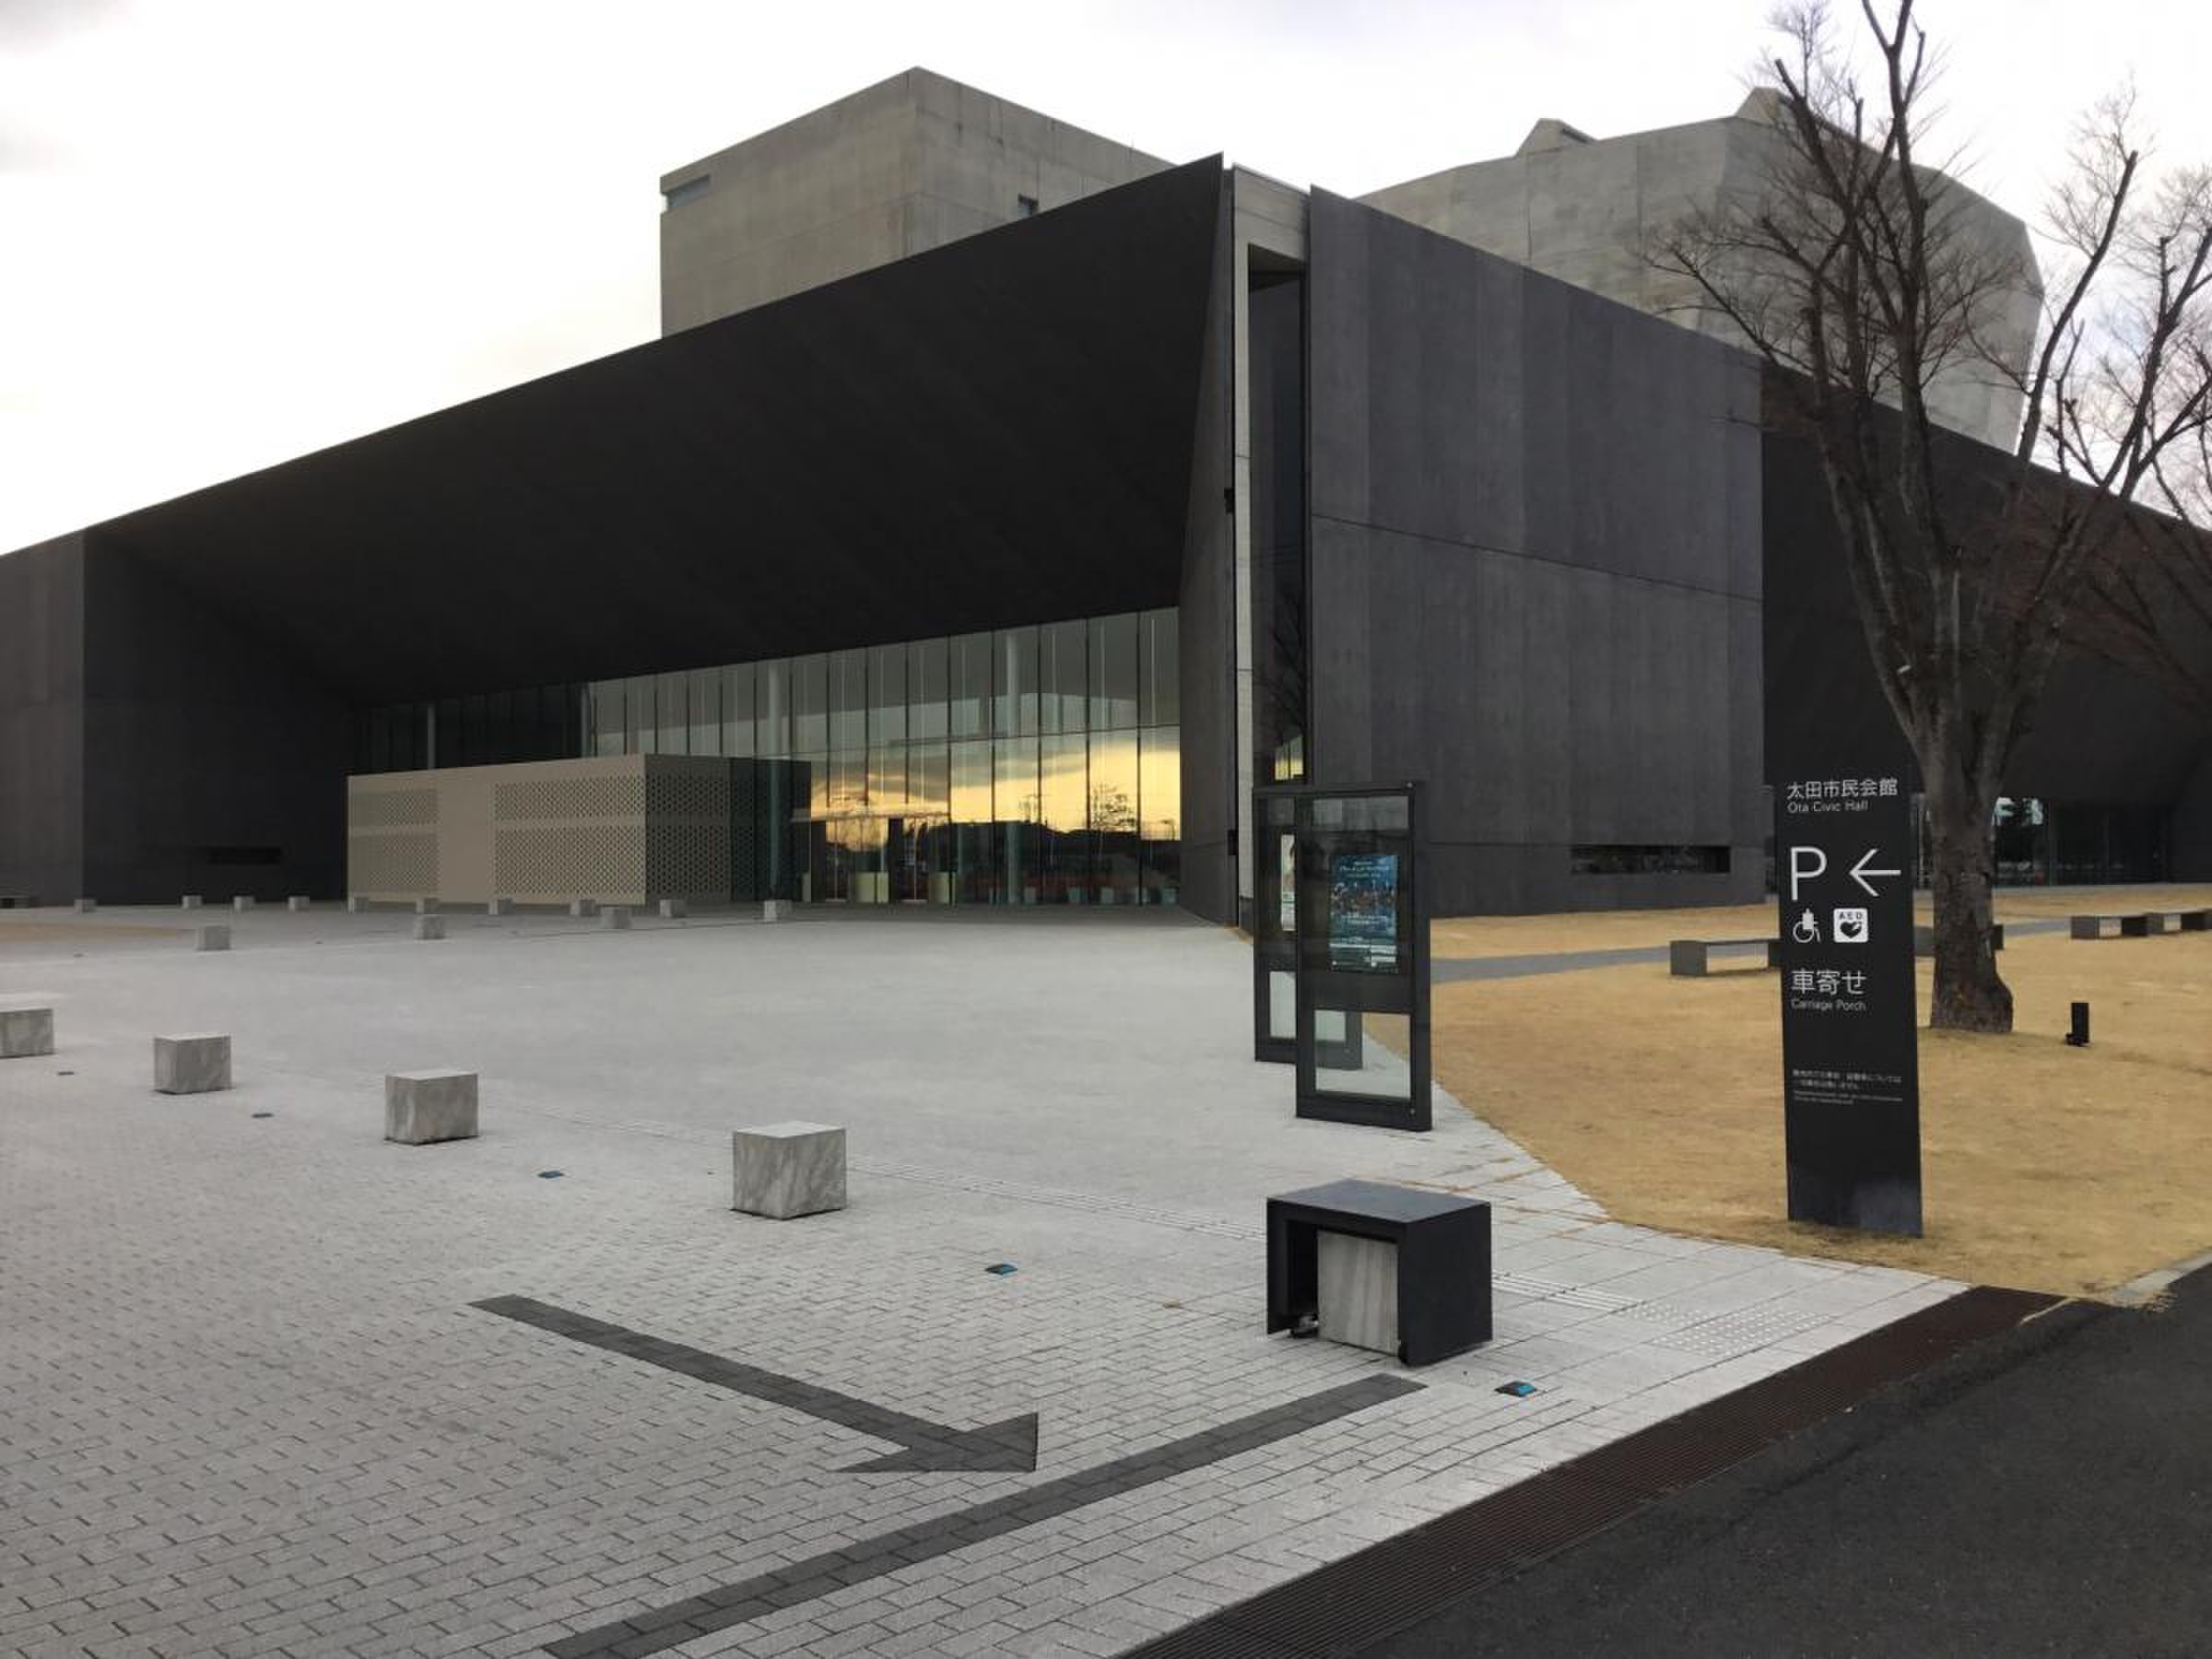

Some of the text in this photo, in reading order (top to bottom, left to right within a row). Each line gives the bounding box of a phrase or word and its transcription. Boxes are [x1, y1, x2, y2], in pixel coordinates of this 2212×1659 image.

[1786, 778, 1899, 799] 太田市民会館
[1787, 799, 1869, 813] Ota Civic Hall
[1790, 846, 1828, 900] P
[1839, 912, 1863, 920] AED
[1791, 968, 1867, 995] 車寄せ
[1791, 998, 1866, 1011] Carriage Porch
